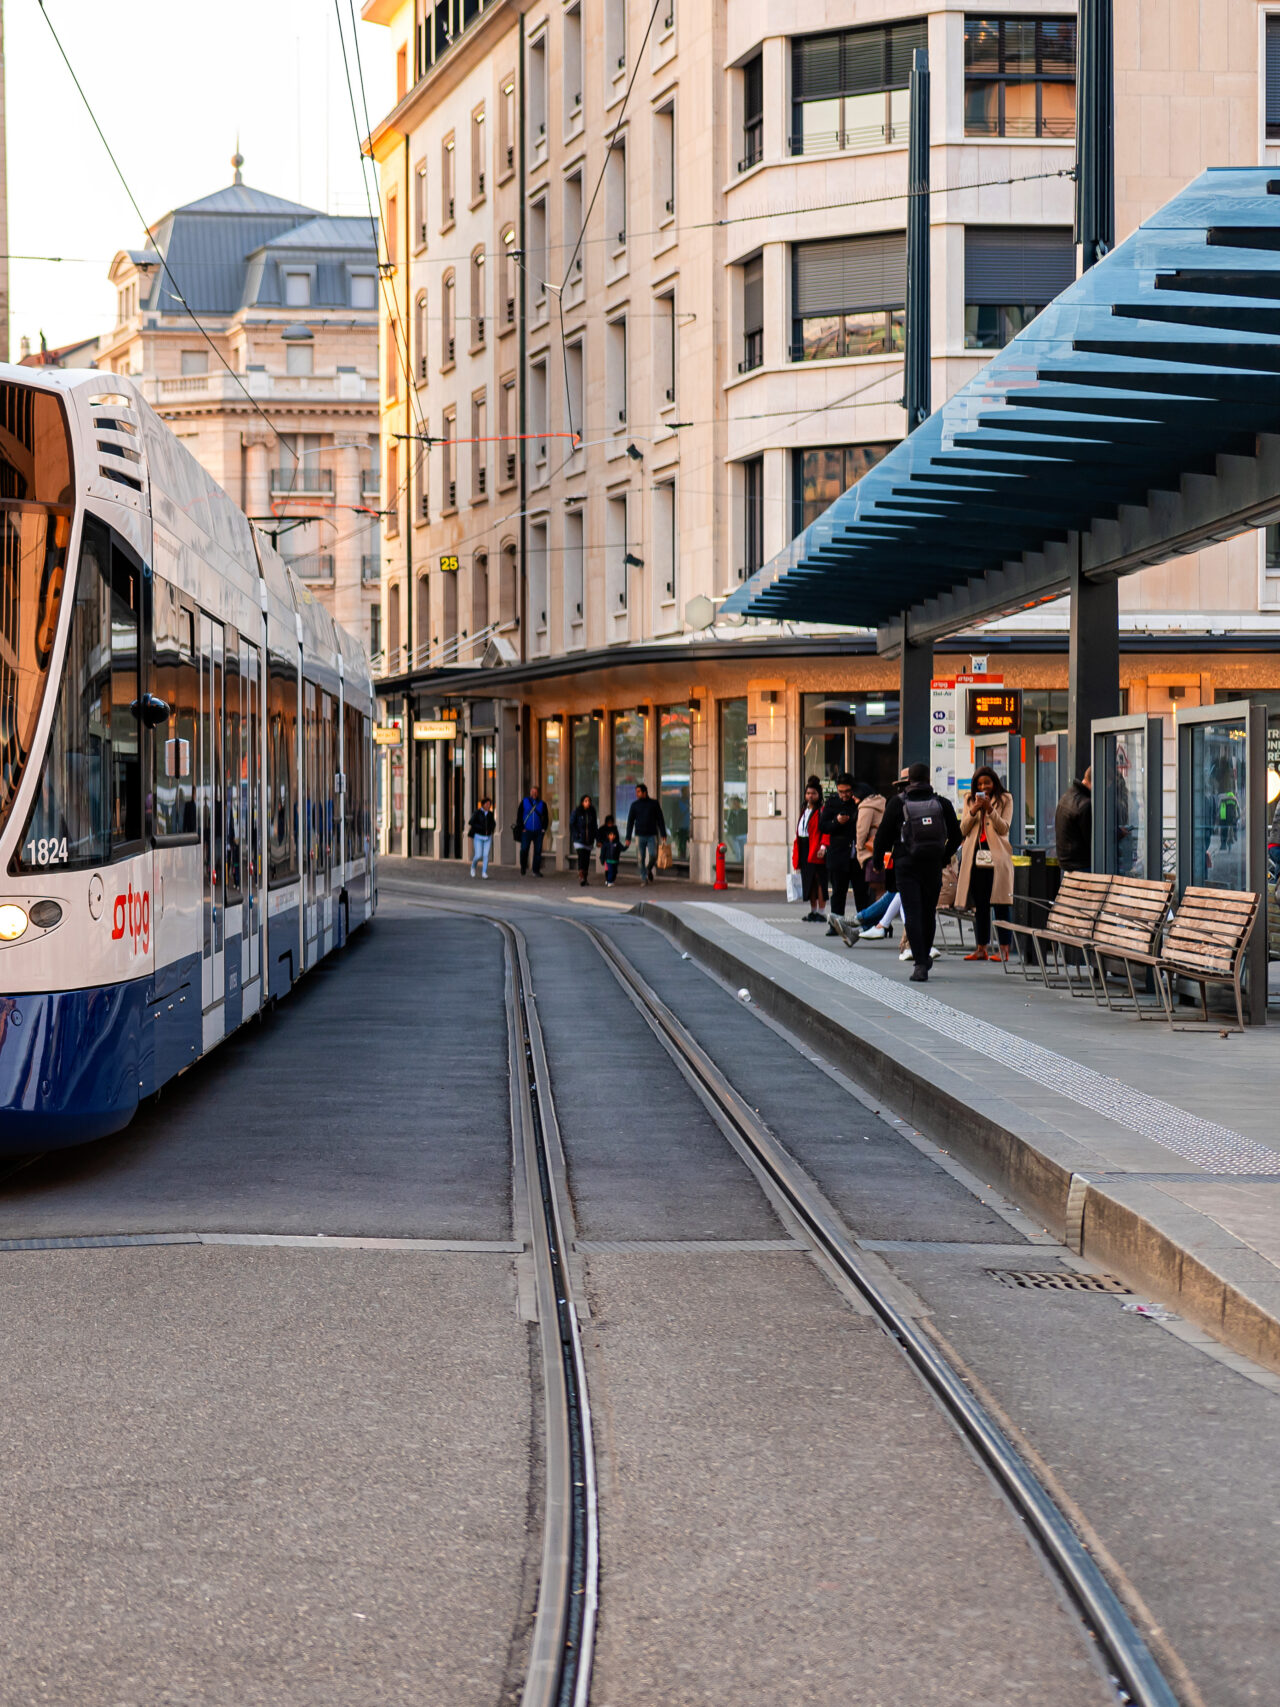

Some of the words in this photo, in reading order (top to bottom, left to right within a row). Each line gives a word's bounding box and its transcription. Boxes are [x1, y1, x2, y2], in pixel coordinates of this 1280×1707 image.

[441, 557, 458, 570] 25
[27, 837, 69, 866] 1824
[128, 882, 150, 956] tpg
